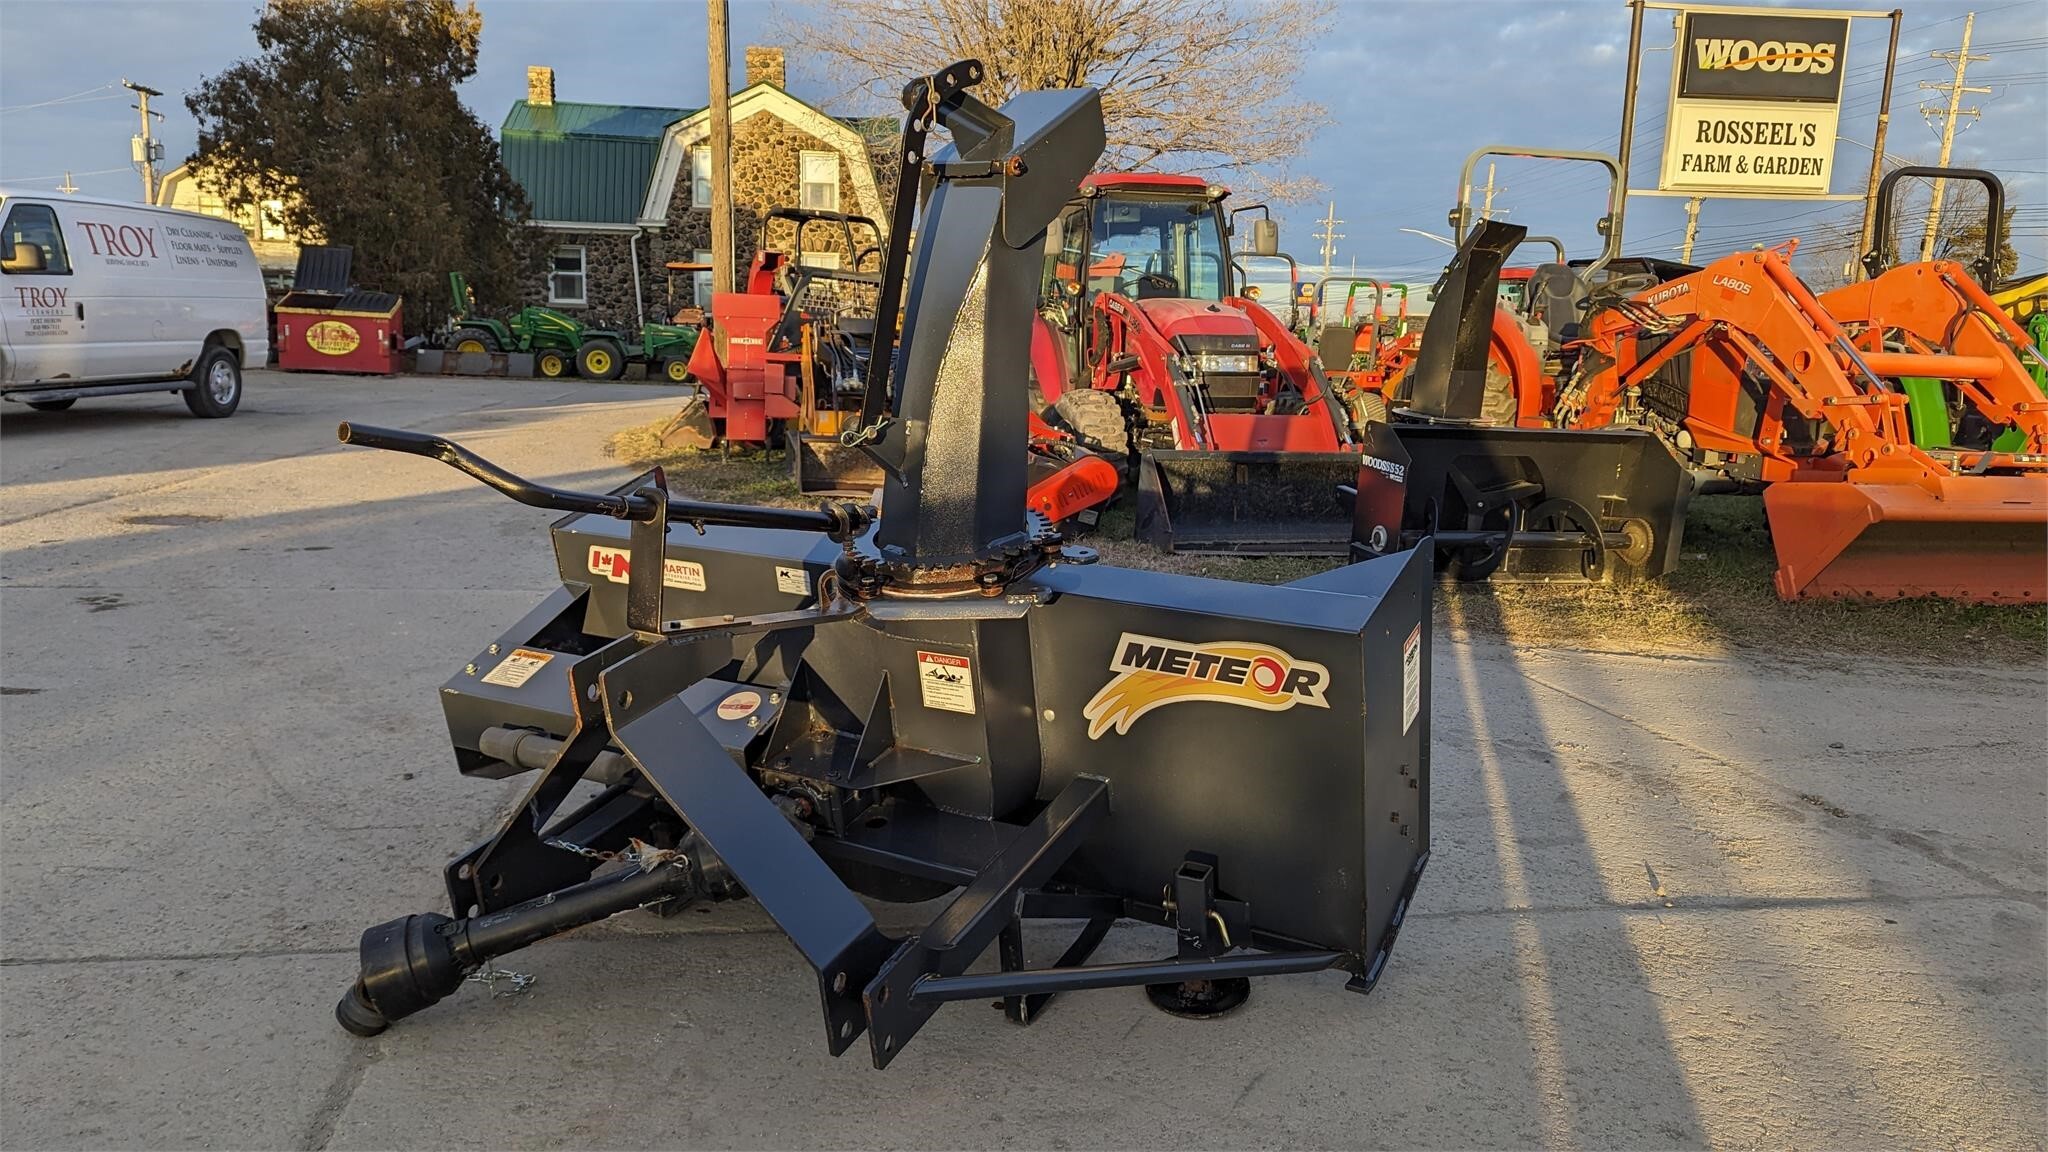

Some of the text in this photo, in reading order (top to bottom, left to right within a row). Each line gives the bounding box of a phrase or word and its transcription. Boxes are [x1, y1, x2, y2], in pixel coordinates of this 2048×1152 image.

[1695, 38, 1836, 75] WOODS
[1695, 119, 1817, 147] ROSSEEL'S
[1681, 154, 1824, 176] FARM & GARDEN
[76, 221, 159, 259] TROY
[14, 287, 68, 308] TROY
[1647, 282, 1690, 304] KUBOTA
[933, 655, 961, 666] DANGER
[1121, 642, 1321, 697] METEOR
